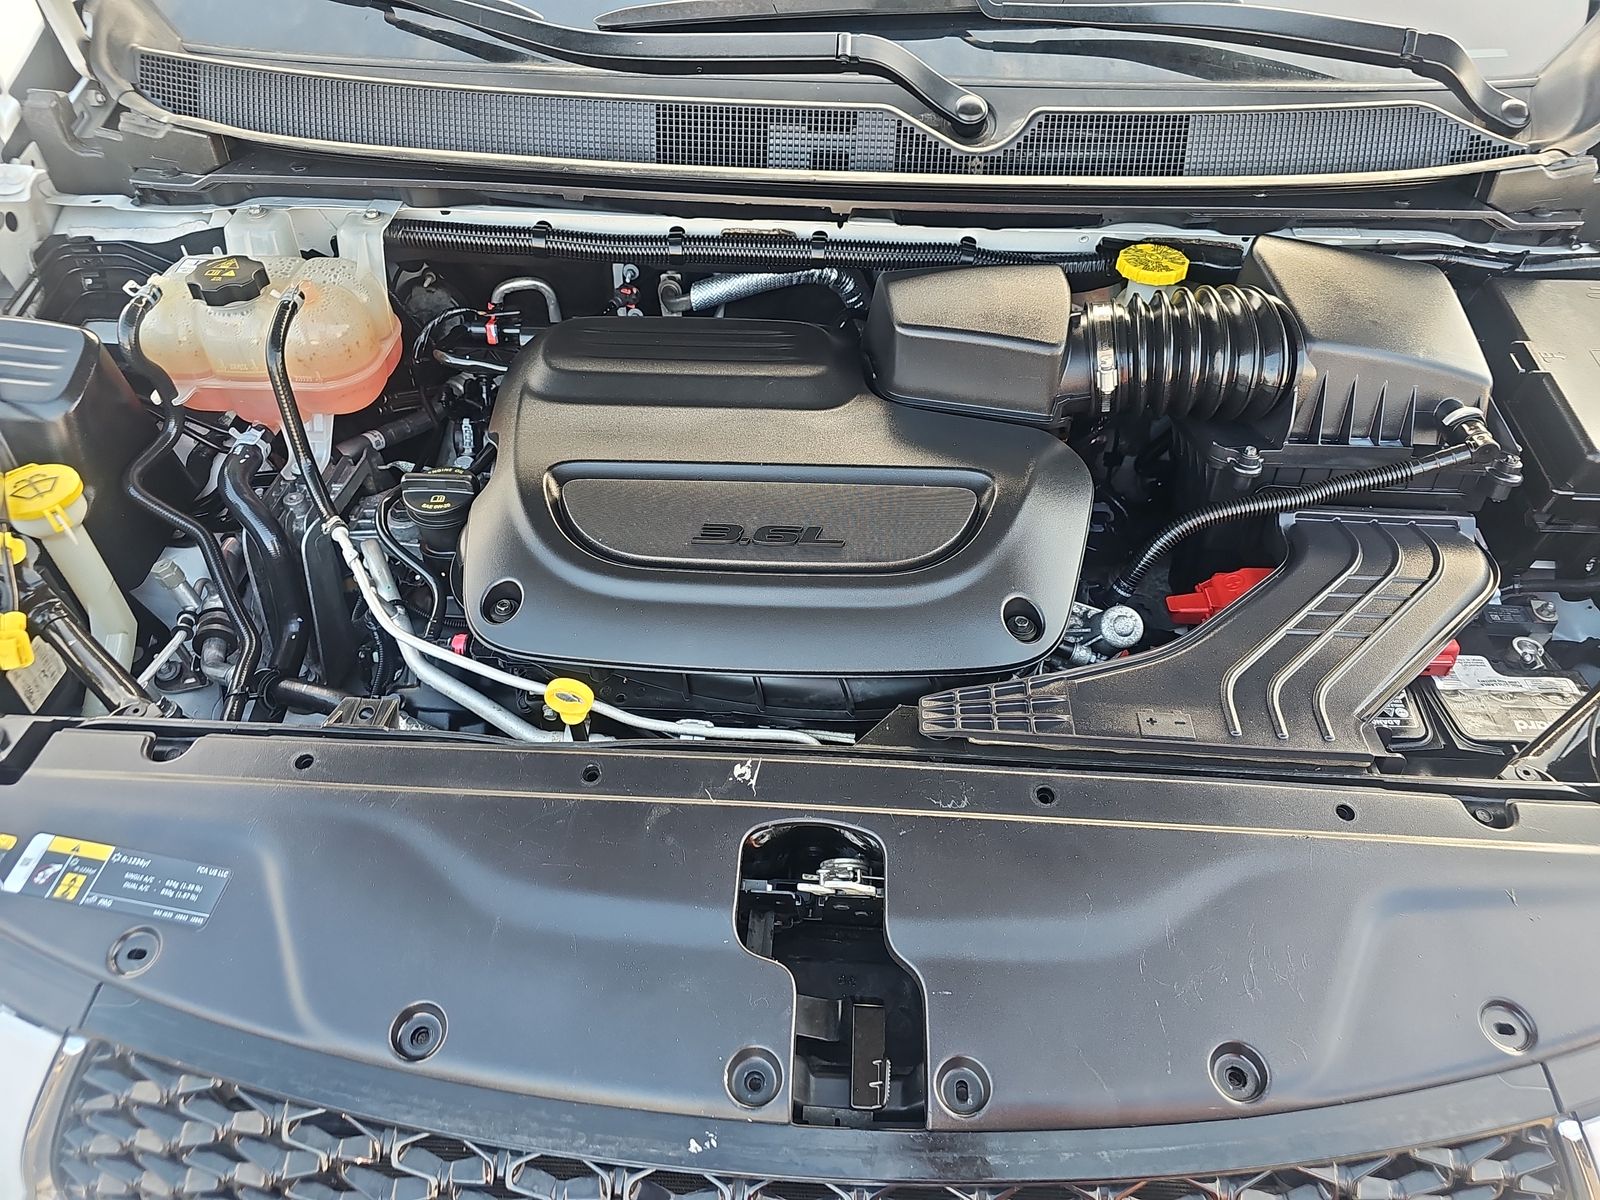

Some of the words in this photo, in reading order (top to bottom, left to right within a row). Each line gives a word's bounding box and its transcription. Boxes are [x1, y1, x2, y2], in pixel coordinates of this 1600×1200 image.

[690, 522, 846, 548] 3.6L
[196, 865, 209, 876] FCA
[208, 868, 219, 877] US
[218, 869, 229, 879] LLC
